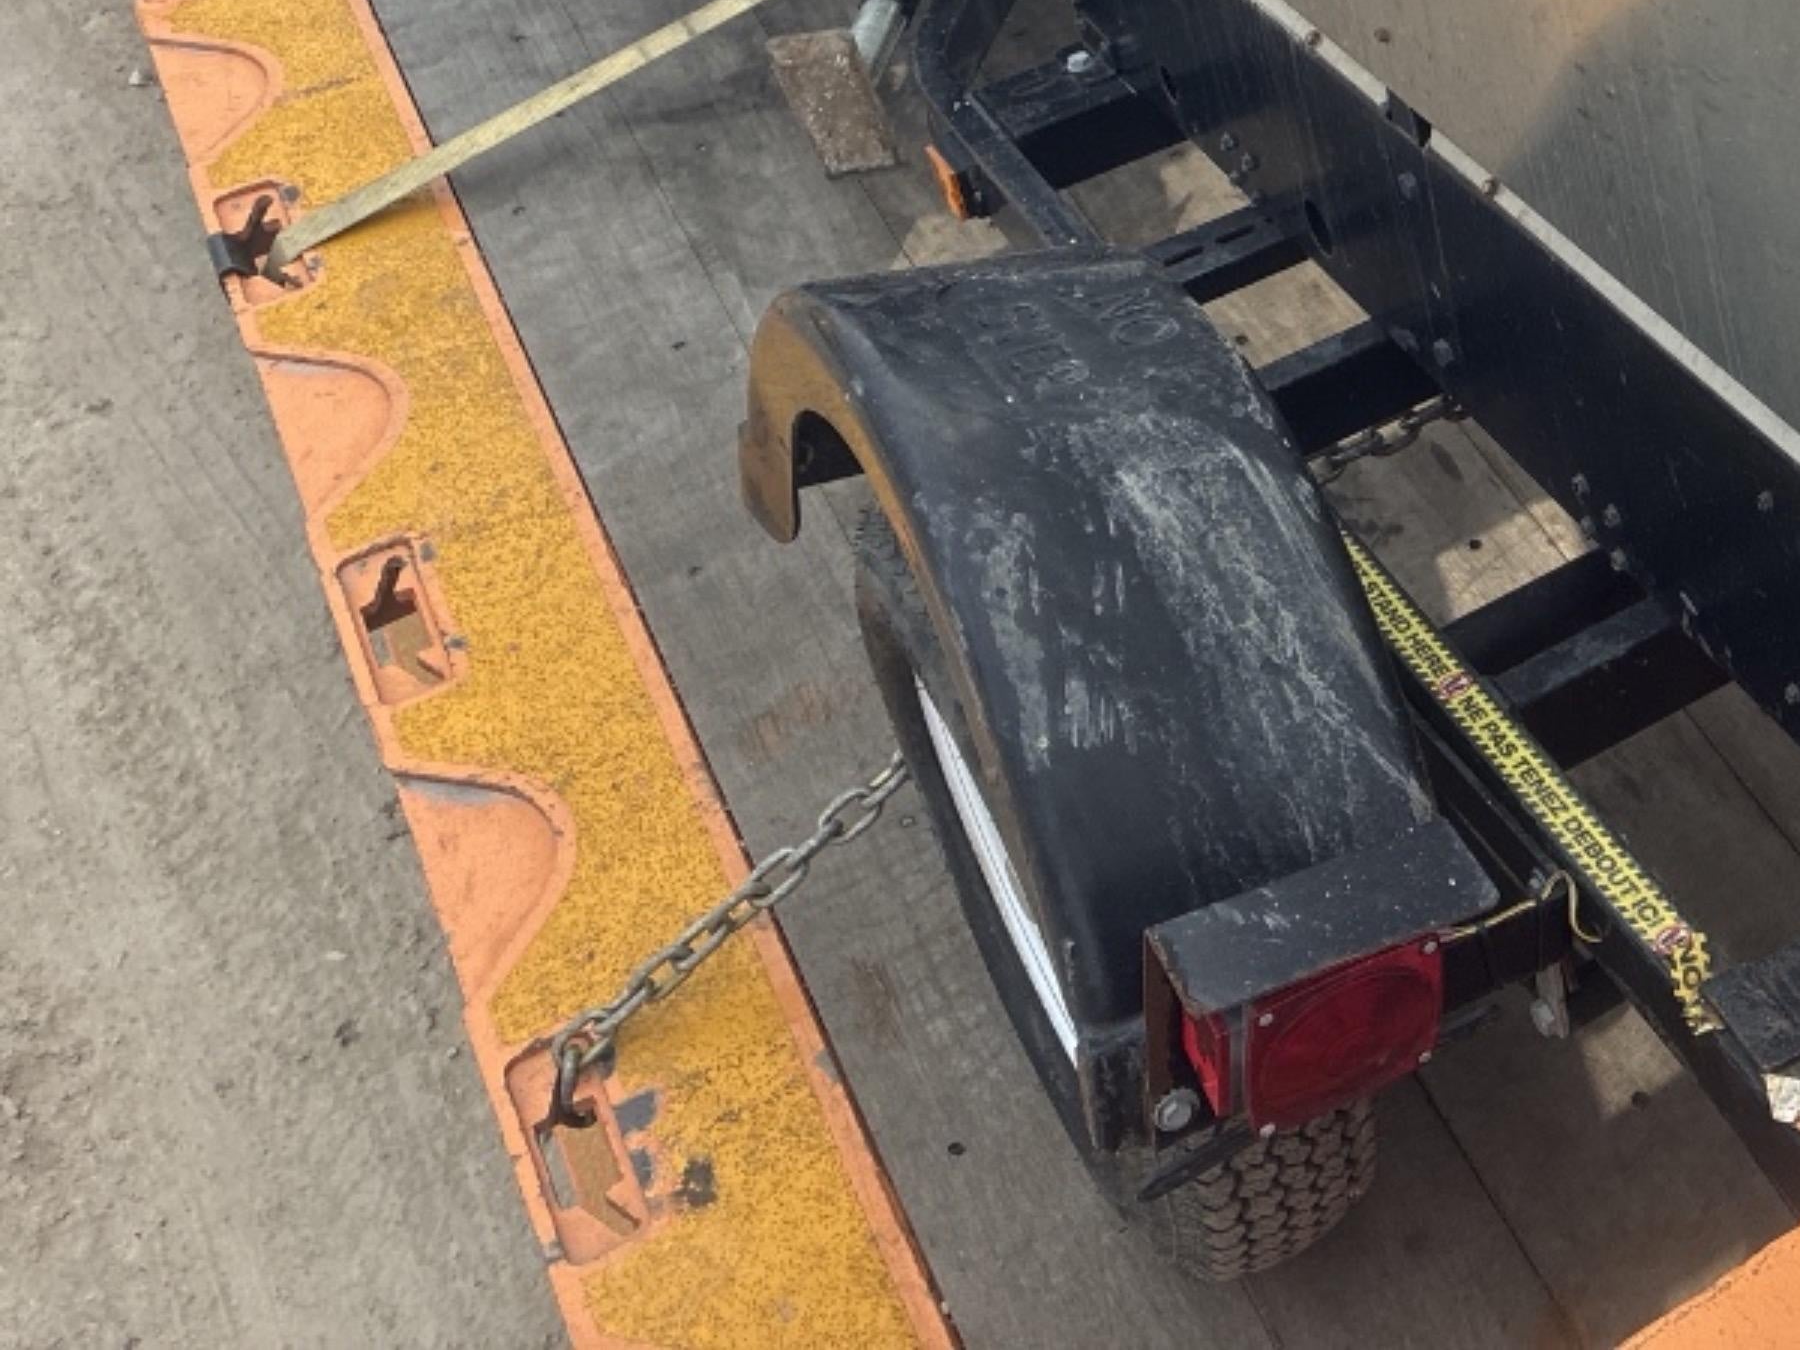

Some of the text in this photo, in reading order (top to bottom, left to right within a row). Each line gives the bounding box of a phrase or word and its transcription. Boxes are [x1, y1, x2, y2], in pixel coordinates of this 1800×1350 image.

[1366, 581, 1666, 929] STAND HERE NE PAS TENEZ DEBOUT ICI
